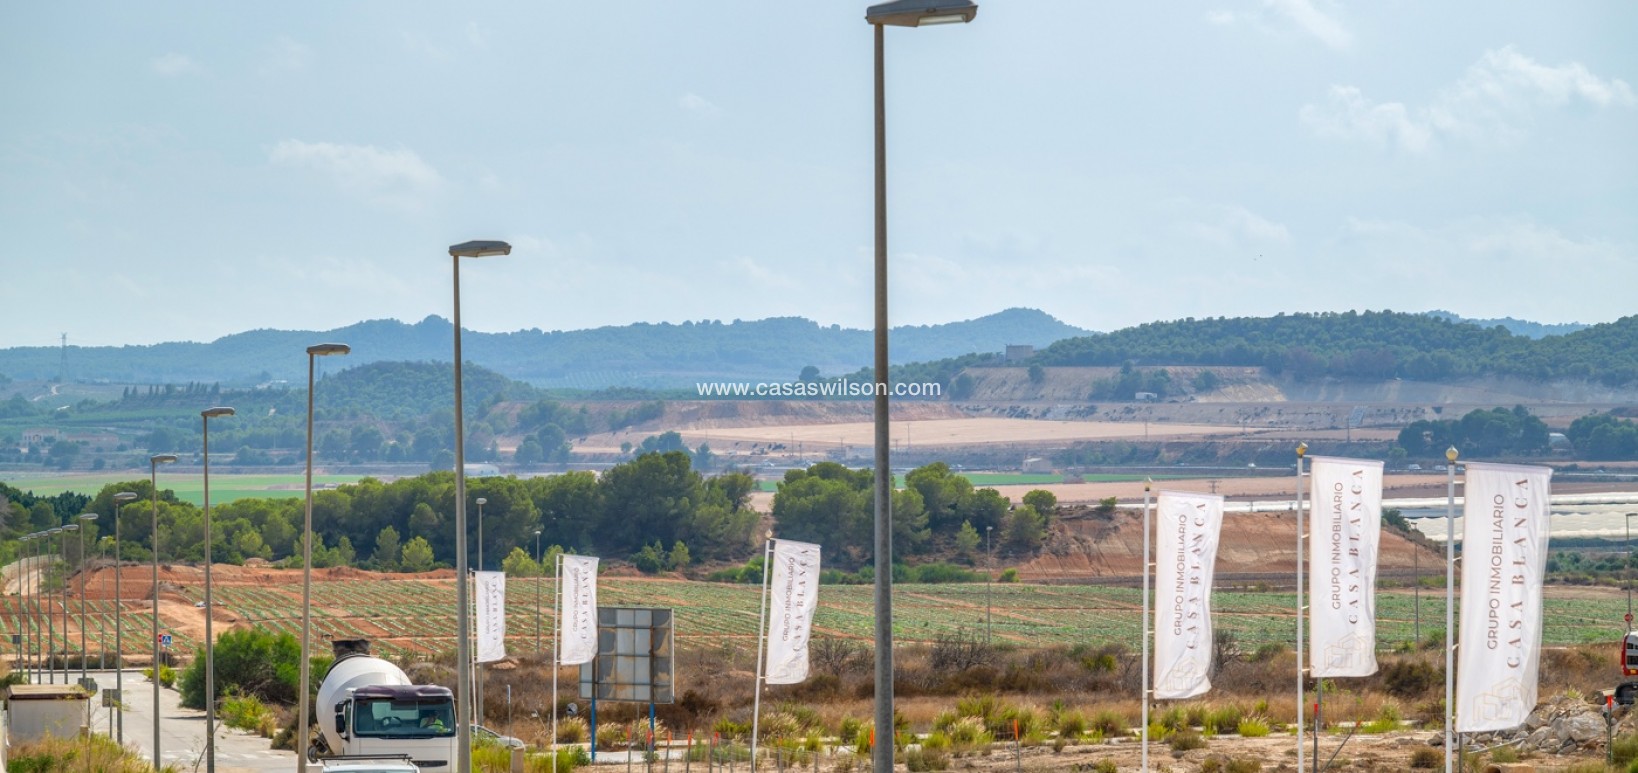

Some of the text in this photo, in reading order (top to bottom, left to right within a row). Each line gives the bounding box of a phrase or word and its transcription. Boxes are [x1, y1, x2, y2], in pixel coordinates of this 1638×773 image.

[782, 557, 795, 642] GRUPO INMOBILIARIO
[1174, 514, 1187, 636] GRUPO INMOBILIARIO
[1186, 503, 1206, 650] CASA BLANCA
[1331, 482, 1344, 610] GRUPO INMOBILIARIO
[1348, 469, 1363, 624] CASA BLANCA
[1487, 494, 1504, 650] GRUPO INMOBILIARIO
[1507, 478, 1528, 668] CASA BLANCA
